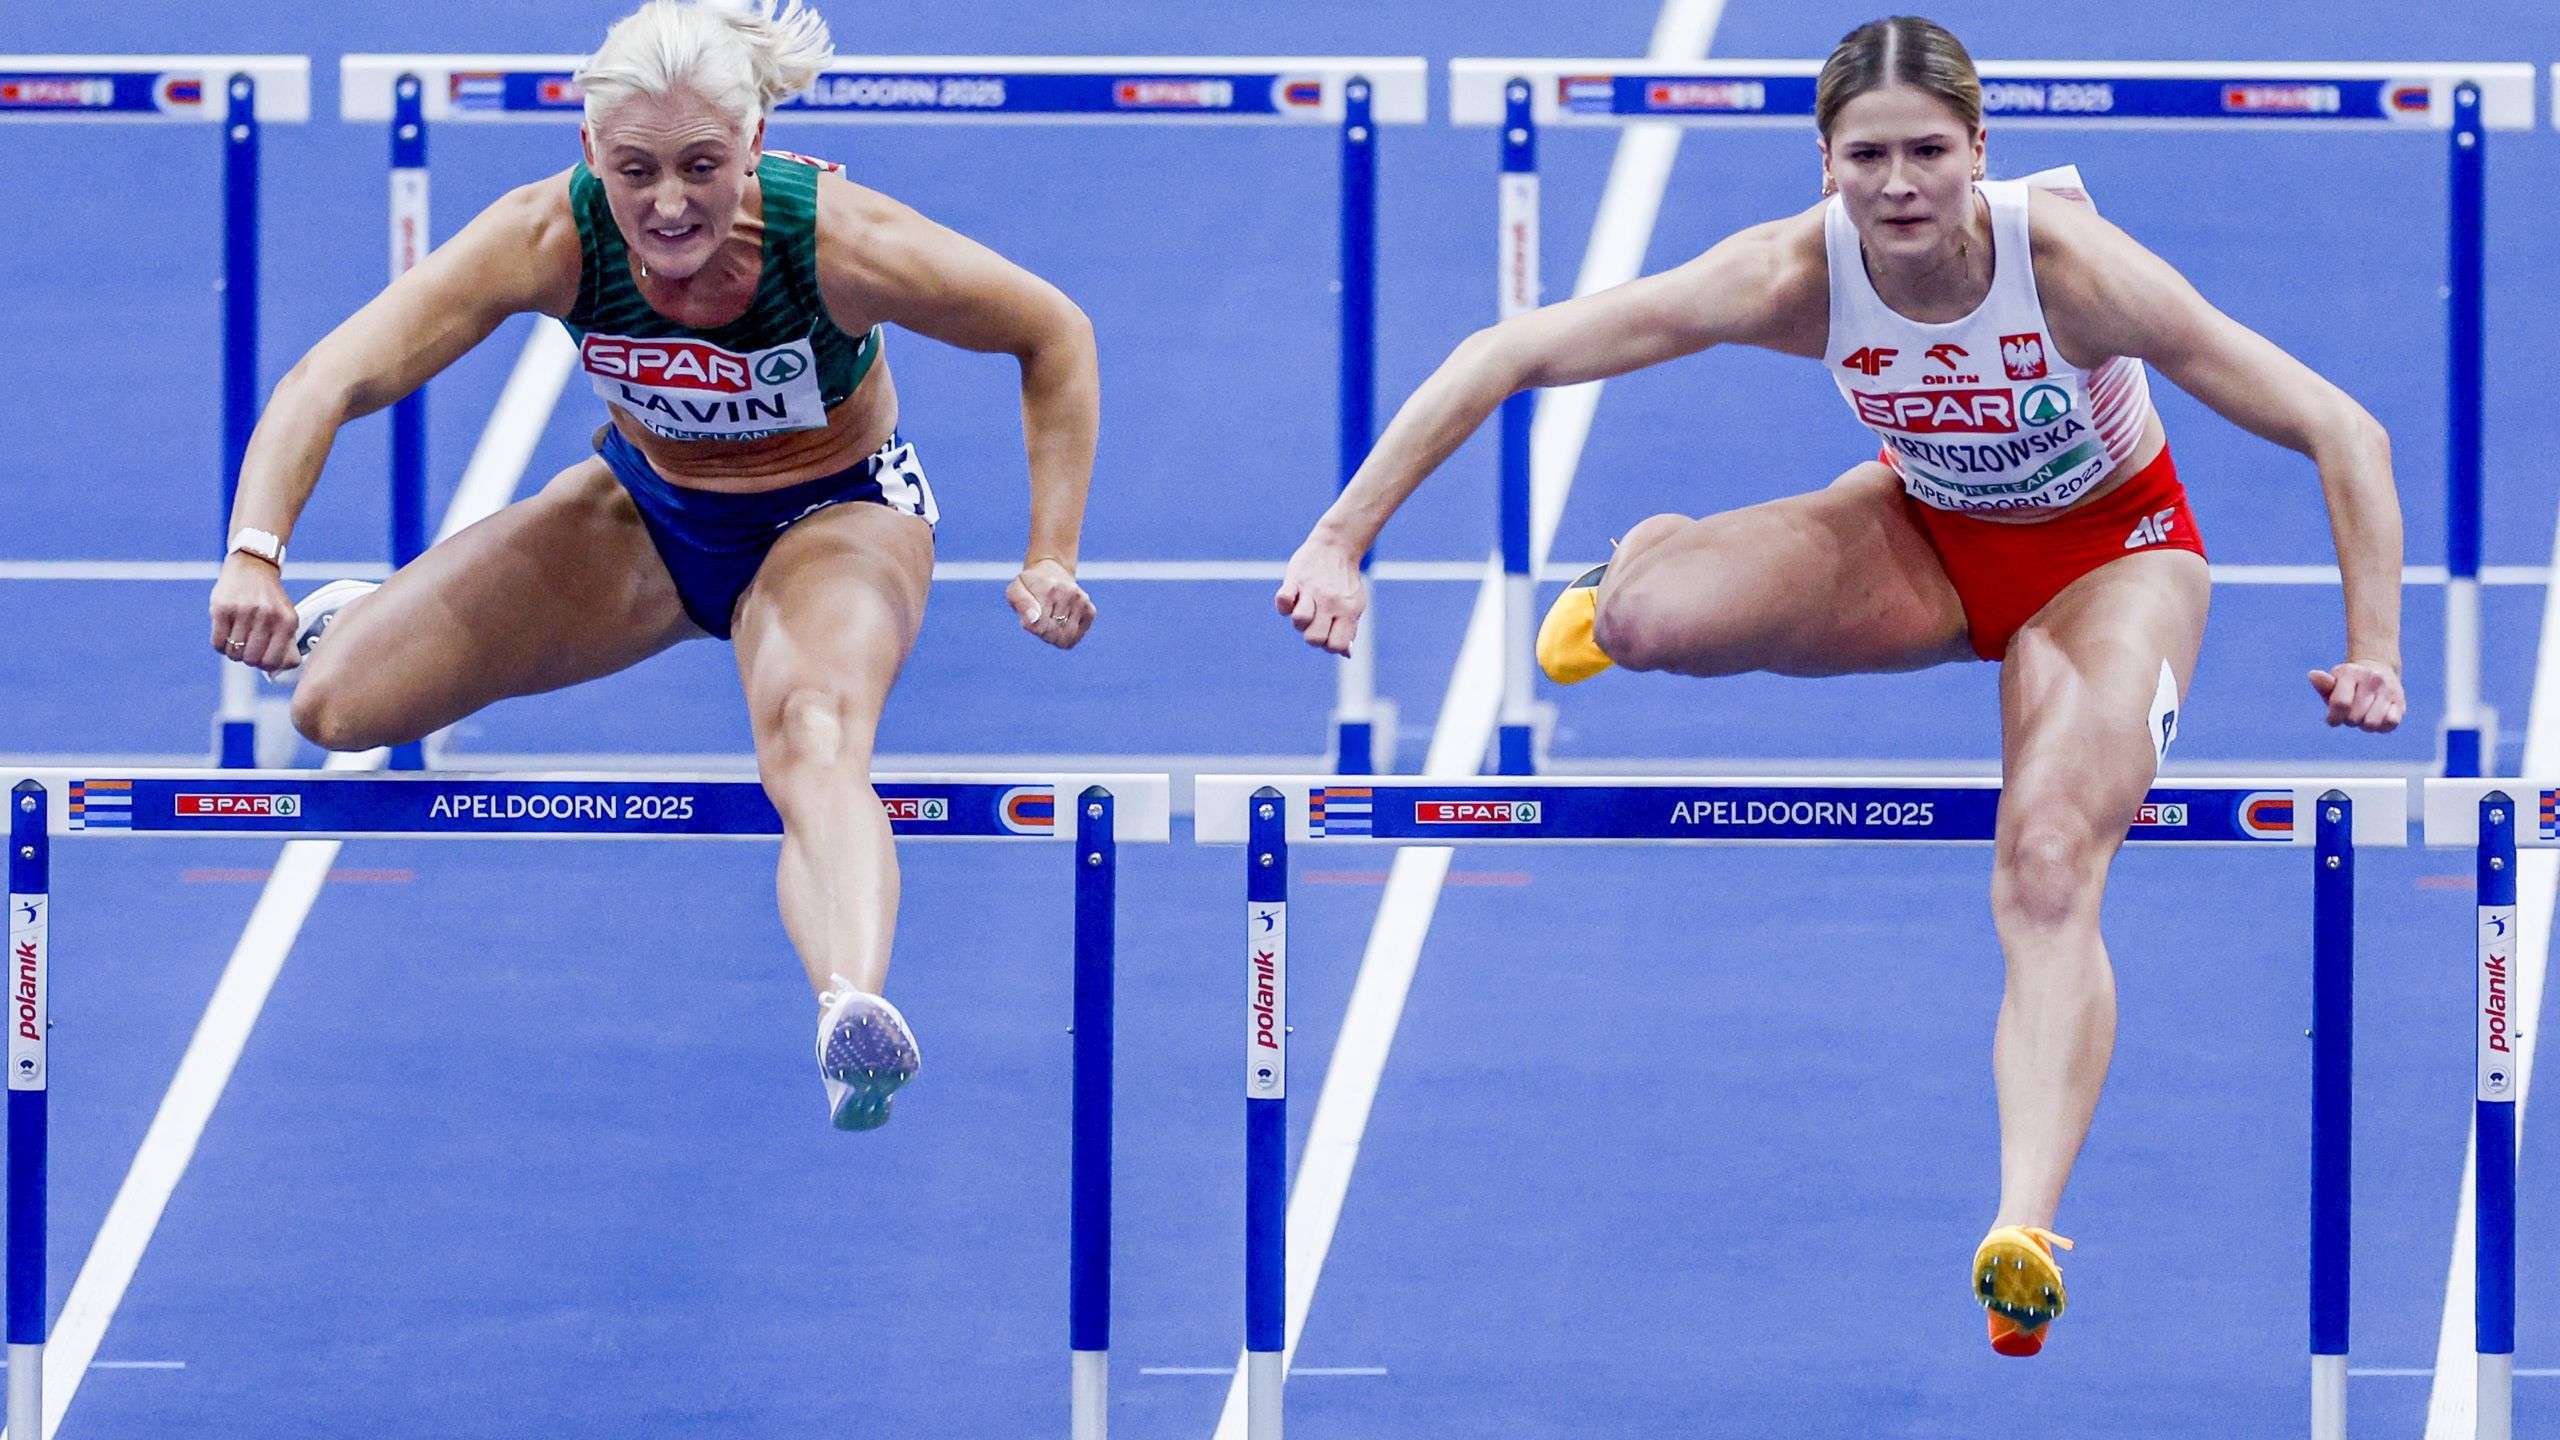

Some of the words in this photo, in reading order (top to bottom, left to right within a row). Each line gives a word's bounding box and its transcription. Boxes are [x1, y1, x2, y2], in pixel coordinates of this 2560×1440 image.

[587, 345, 746, 387] SPAR
[1842, 346, 1899, 376] 4F
[620, 384, 787, 423] LAVIN
[1858, 395, 2012, 428] SPAR
[1875, 418, 2085, 474] KRZYSZOWSKA
[2124, 507, 2175, 549] 4F
[198, 798, 270, 812] SPAR
[429, 795, 616, 818] APELDOORN
[624, 796, 694, 819] 2025
[884, 802, 917, 816] AR
[1438, 805, 1510, 819] SPAR
[1670, 801, 1857, 825] APELDOORN
[1865, 803, 1934, 826] 2025
[15, 940, 40, 1041] polanik
[1253, 949, 1278, 1050] polanik
[2484, 953, 2511, 1053] polanik
